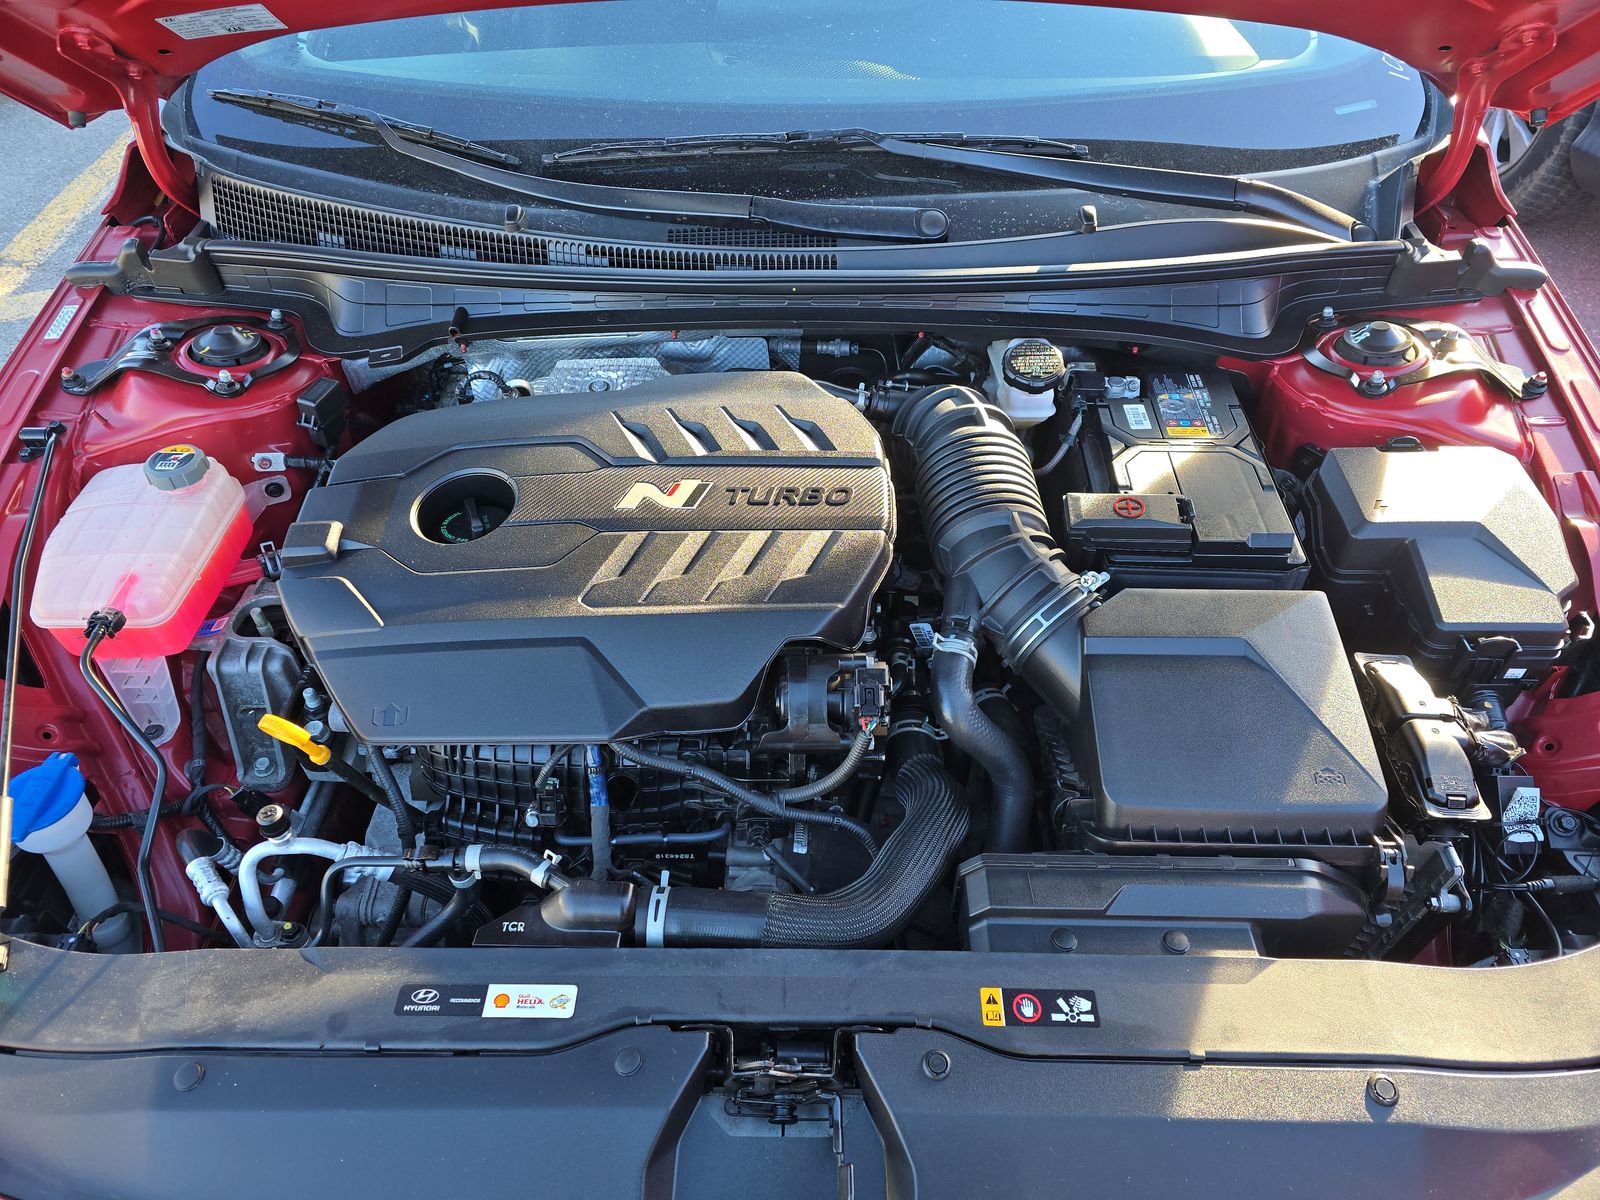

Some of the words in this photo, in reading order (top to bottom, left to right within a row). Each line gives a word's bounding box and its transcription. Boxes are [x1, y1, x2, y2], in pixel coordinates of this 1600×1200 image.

[725, 486, 854, 506] TURBO
[502, 921, 525, 932] TCR
[403, 1004, 441, 1012] HYUNDAI
